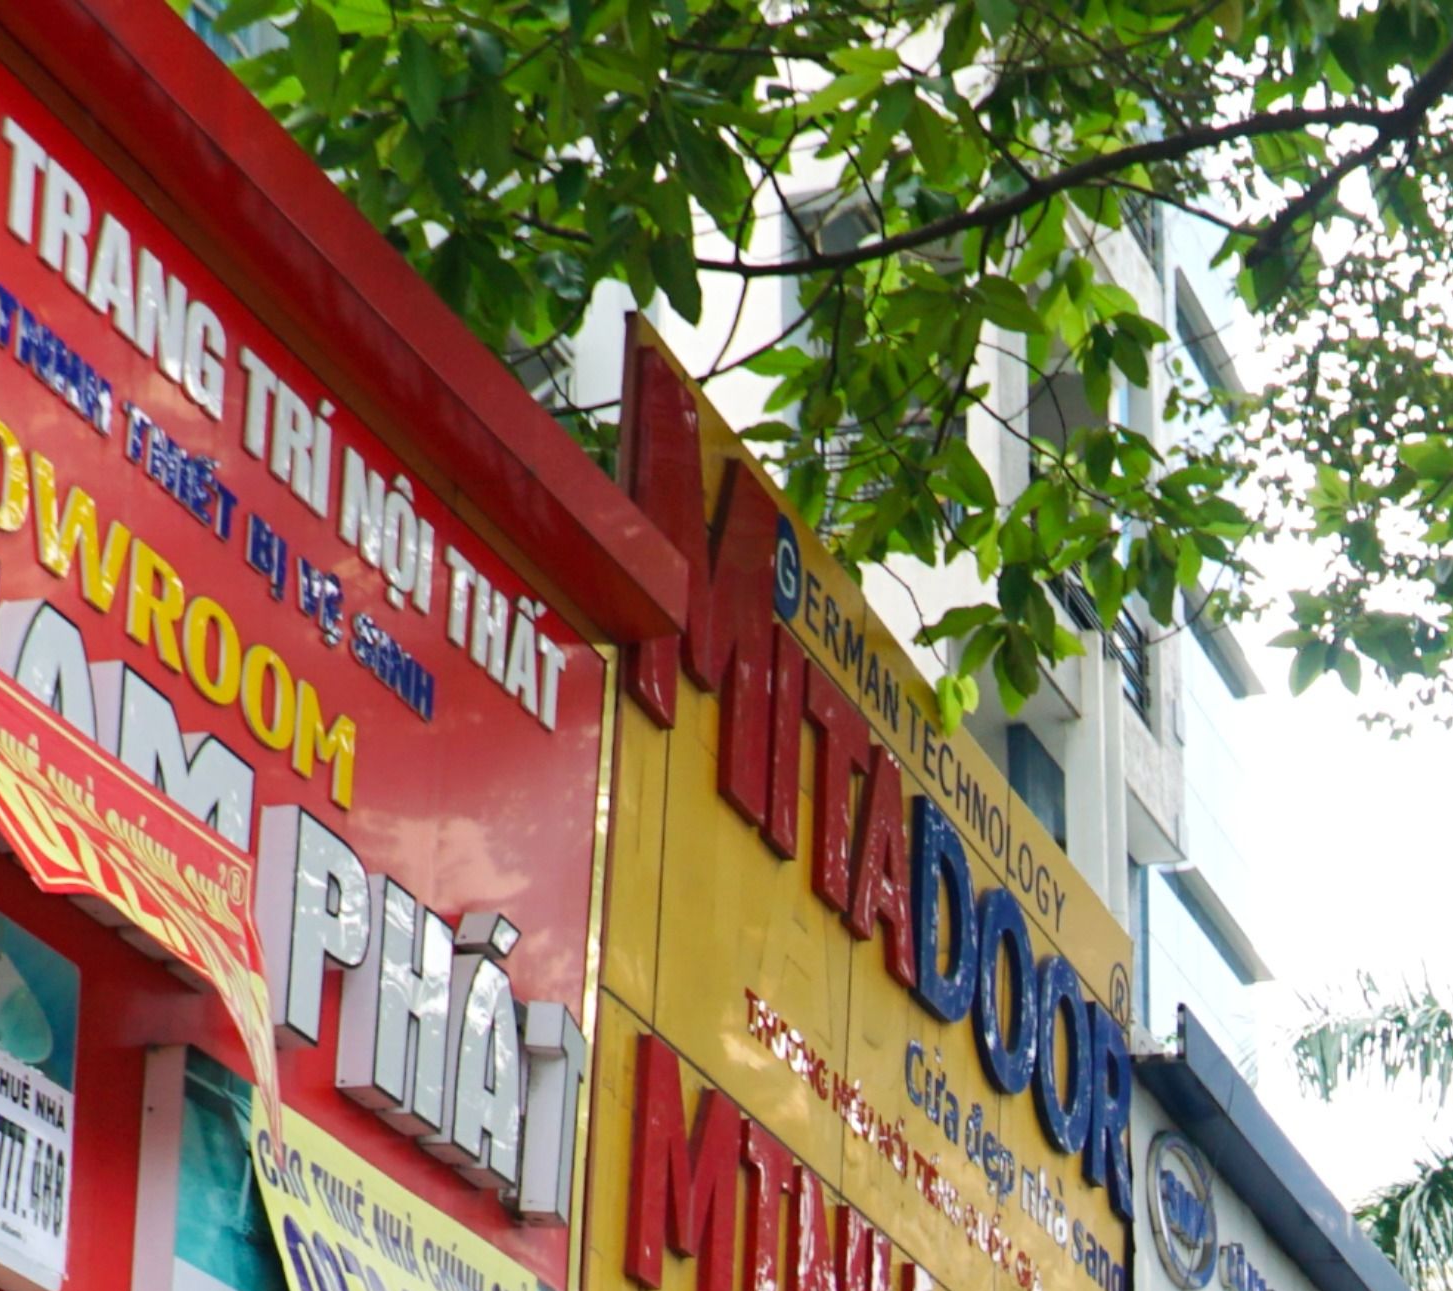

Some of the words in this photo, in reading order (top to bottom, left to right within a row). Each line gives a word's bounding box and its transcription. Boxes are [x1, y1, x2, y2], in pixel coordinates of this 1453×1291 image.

[2, 115, 227, 420] TRANG
[240, 346, 336, 519] TRÍ
[339, 444, 436, 616] NỘI
[445, 544, 567, 731] THẤT
[247, 511, 288, 602] BỊ
[351, 612, 436, 723] SINH
[774, 511, 901, 742] GERMAN
[905, 694, 1066, 934] TECHNOLOGY
[35, 1089, 67, 1132] NHÀ
[256, 1128, 311, 1208] CHO
[310, 1161, 374, 1249] THUÊ
[373, 1202, 425, 1282] NHÀ
[905, 1038, 959, 1146] Cửa
[964, 1101, 1015, 1205] đẹp
[1021, 1164, 1069, 1245] nhà
